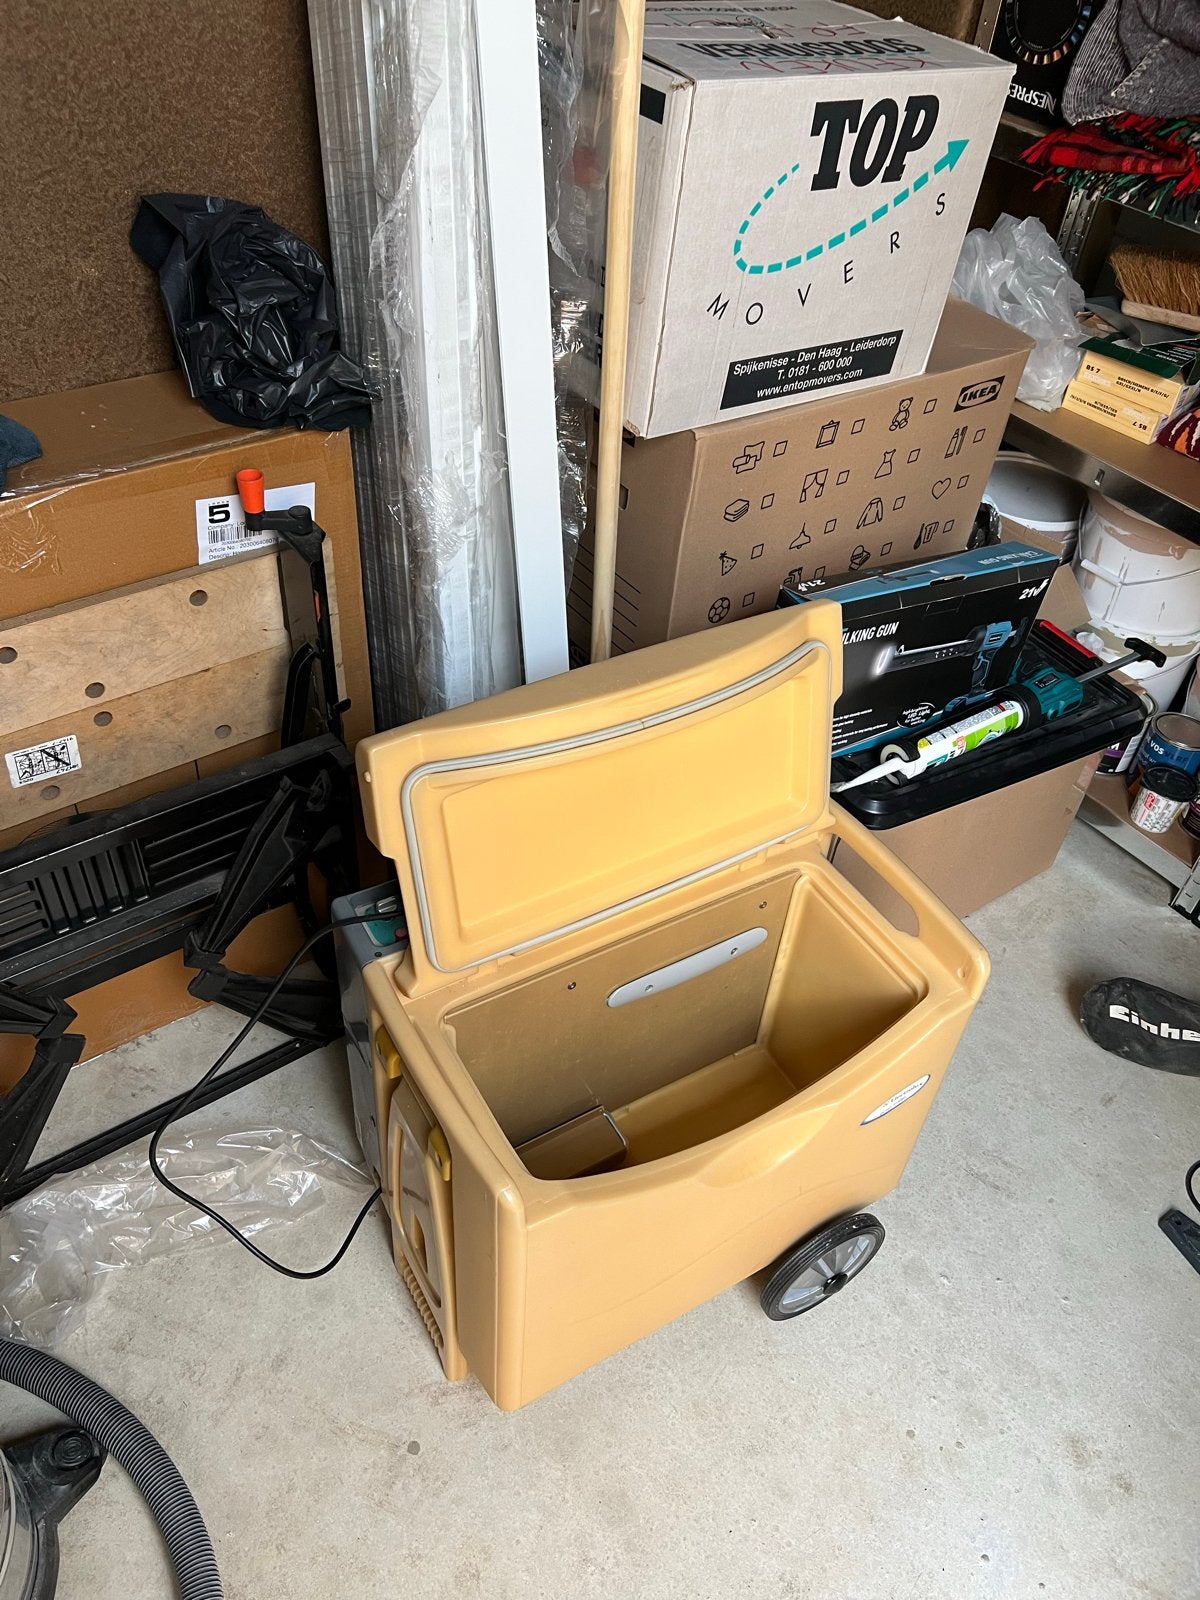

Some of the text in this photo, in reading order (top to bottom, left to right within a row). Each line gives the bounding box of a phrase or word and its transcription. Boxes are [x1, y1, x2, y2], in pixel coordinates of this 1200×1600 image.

[677, 37, 926, 58] VERHUISDOOS
[1009, 82, 1057, 116] NESPRE
[810, 94, 940, 192] TOP
[706, 192, 946, 326] MOVERS
[733, 357, 788, 377] Spijkenisse
[797, 351, 816, 363] Den
[818, 346, 842, 360] Haag
[850, 335, 897, 353] Leiderdorp
[777, 369, 786, 381] T.
[788, 365, 810, 379] 0181
[818, 360, 835, 372] 600
[835, 356, 853, 368] 000
[756, 367, 863, 398] www.entopmovers.com
[961, 384, 998, 403] IKEA
[208, 503, 231, 524] 5
[876, 621, 900, 638] GUN
